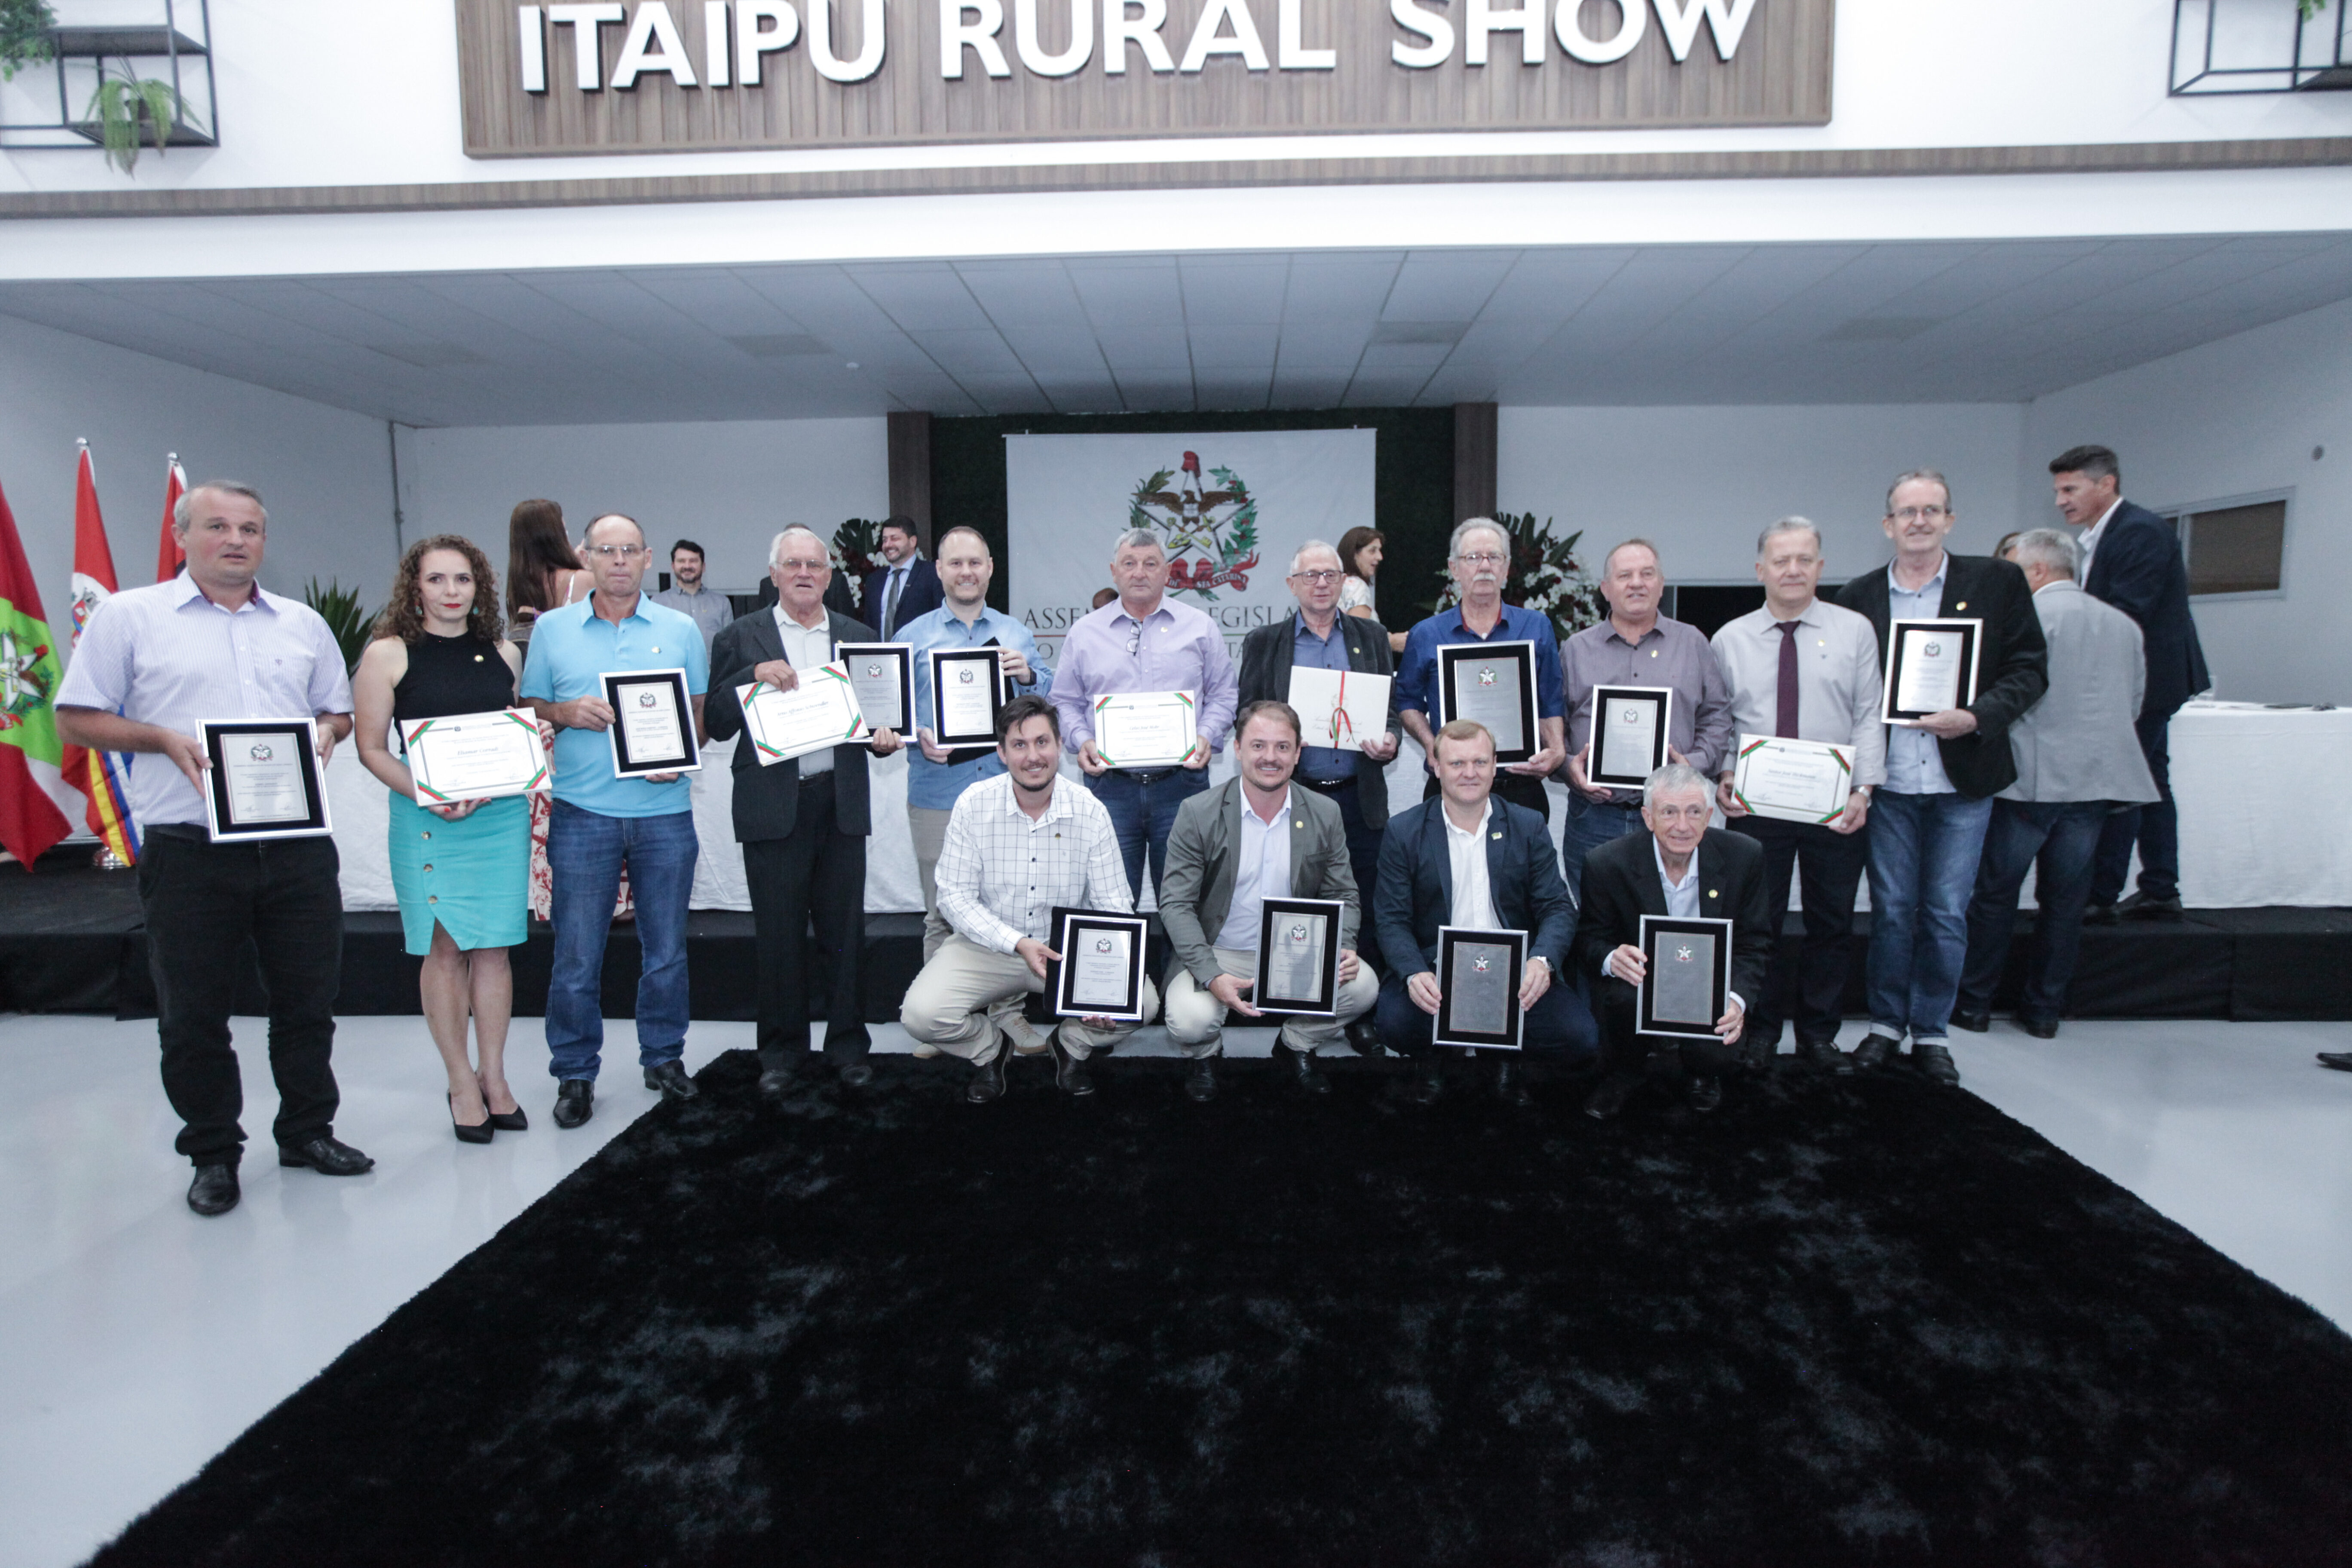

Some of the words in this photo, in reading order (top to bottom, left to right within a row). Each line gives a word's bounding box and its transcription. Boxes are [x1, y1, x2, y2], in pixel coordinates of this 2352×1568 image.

[518, 0, 887, 91] ITAIPU
[940, 0, 1336, 79] RURAL
[1390, 0, 1757, 68] SHOW
